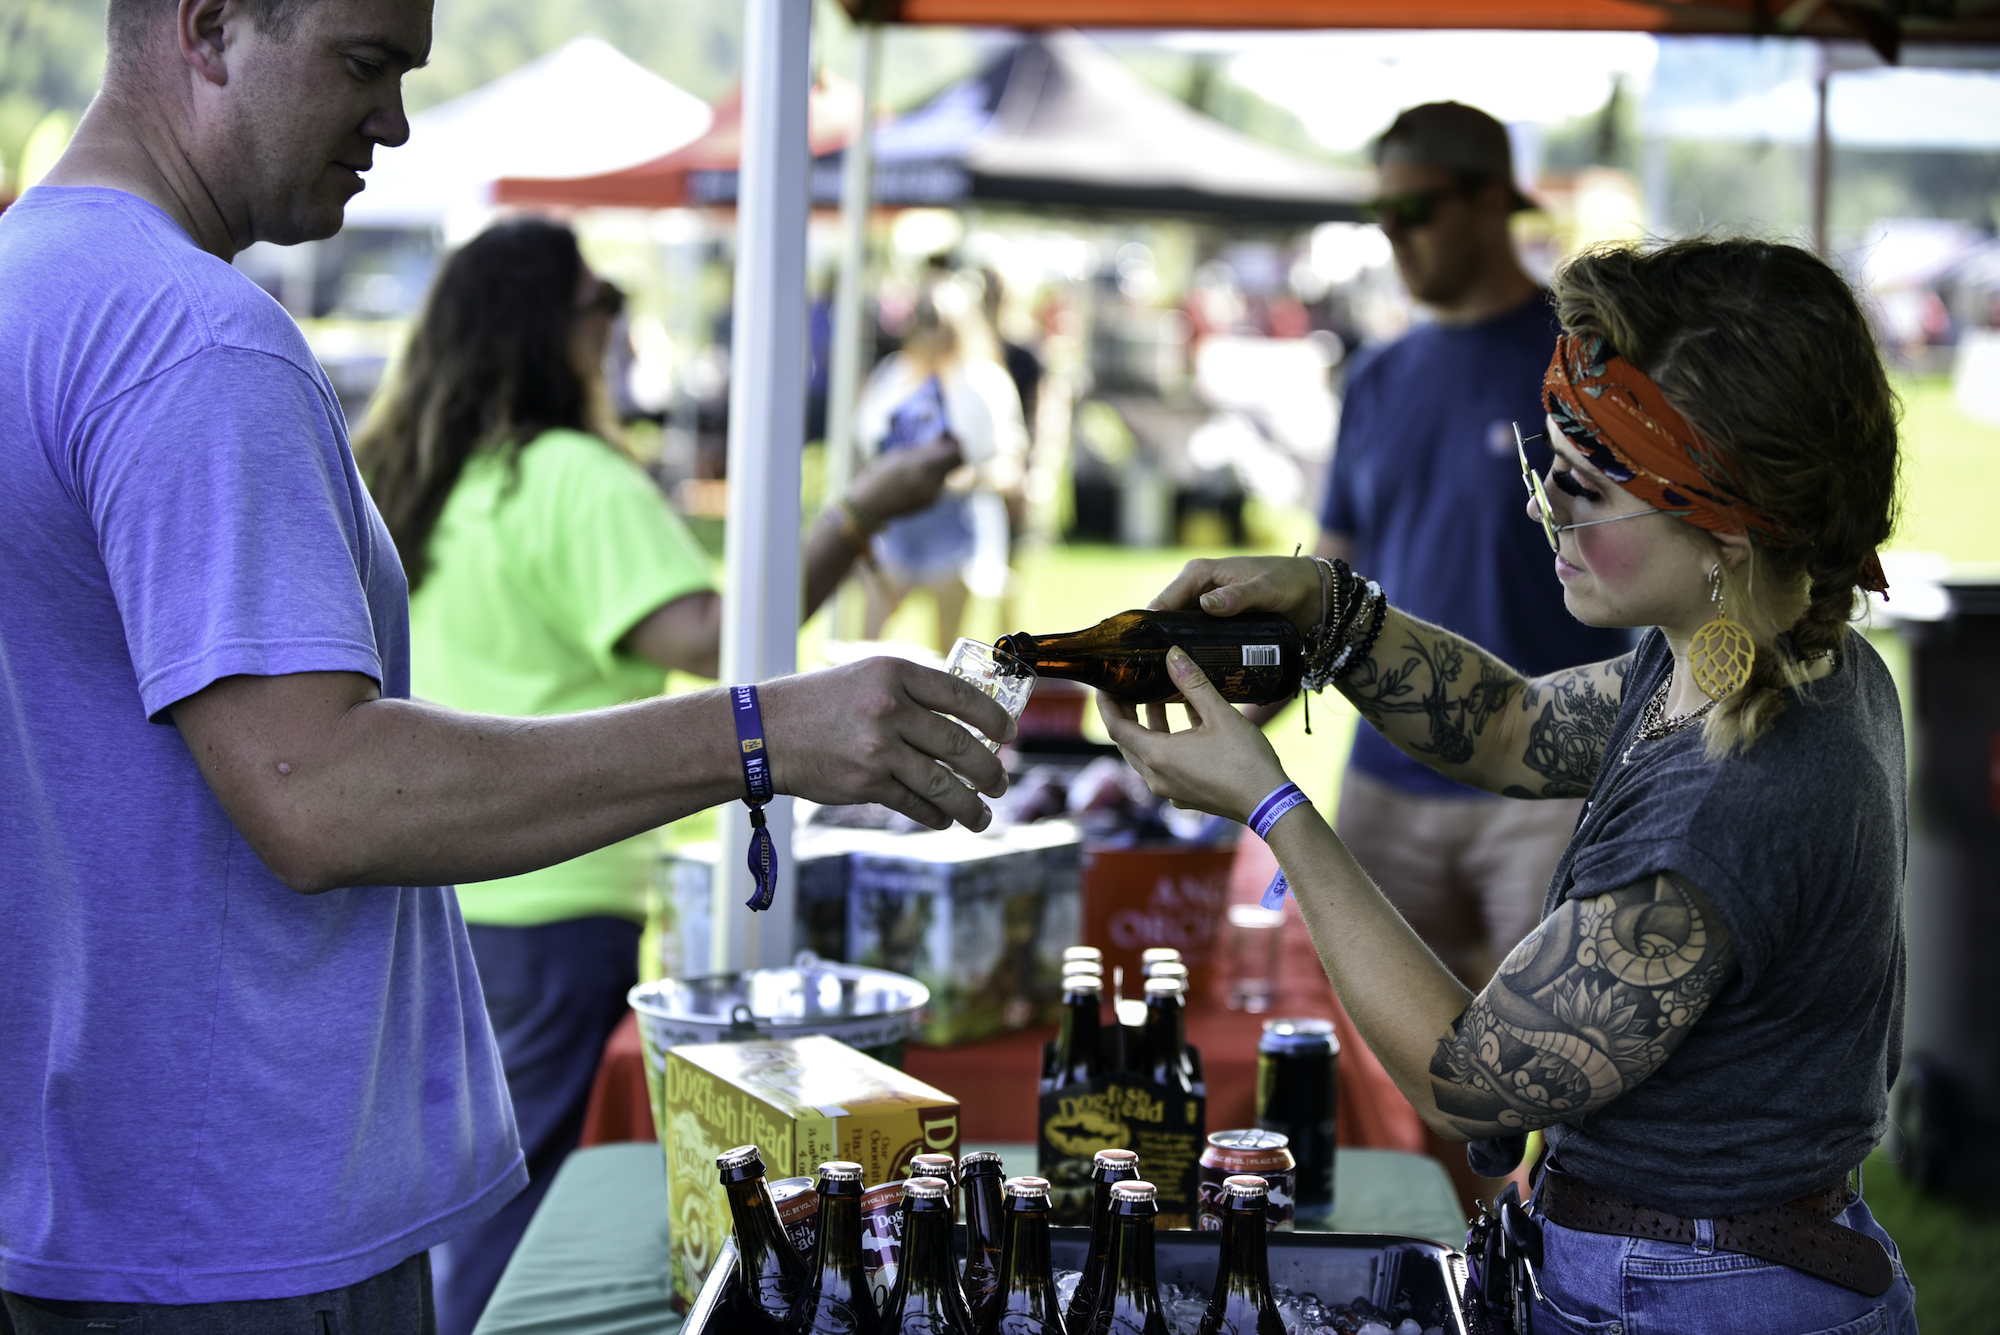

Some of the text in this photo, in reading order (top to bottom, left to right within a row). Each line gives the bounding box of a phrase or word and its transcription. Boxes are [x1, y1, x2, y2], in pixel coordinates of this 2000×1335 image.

[1268, 798, 1294, 820] Plasma
[761, 836, 771, 873] CURDS
[1058, 1084, 1152, 1119] Dogfish
[1105, 1100, 1165, 1123] Head
[666, 1057, 791, 1176] Dogfish Head
[792, 1206, 800, 1214] BY
